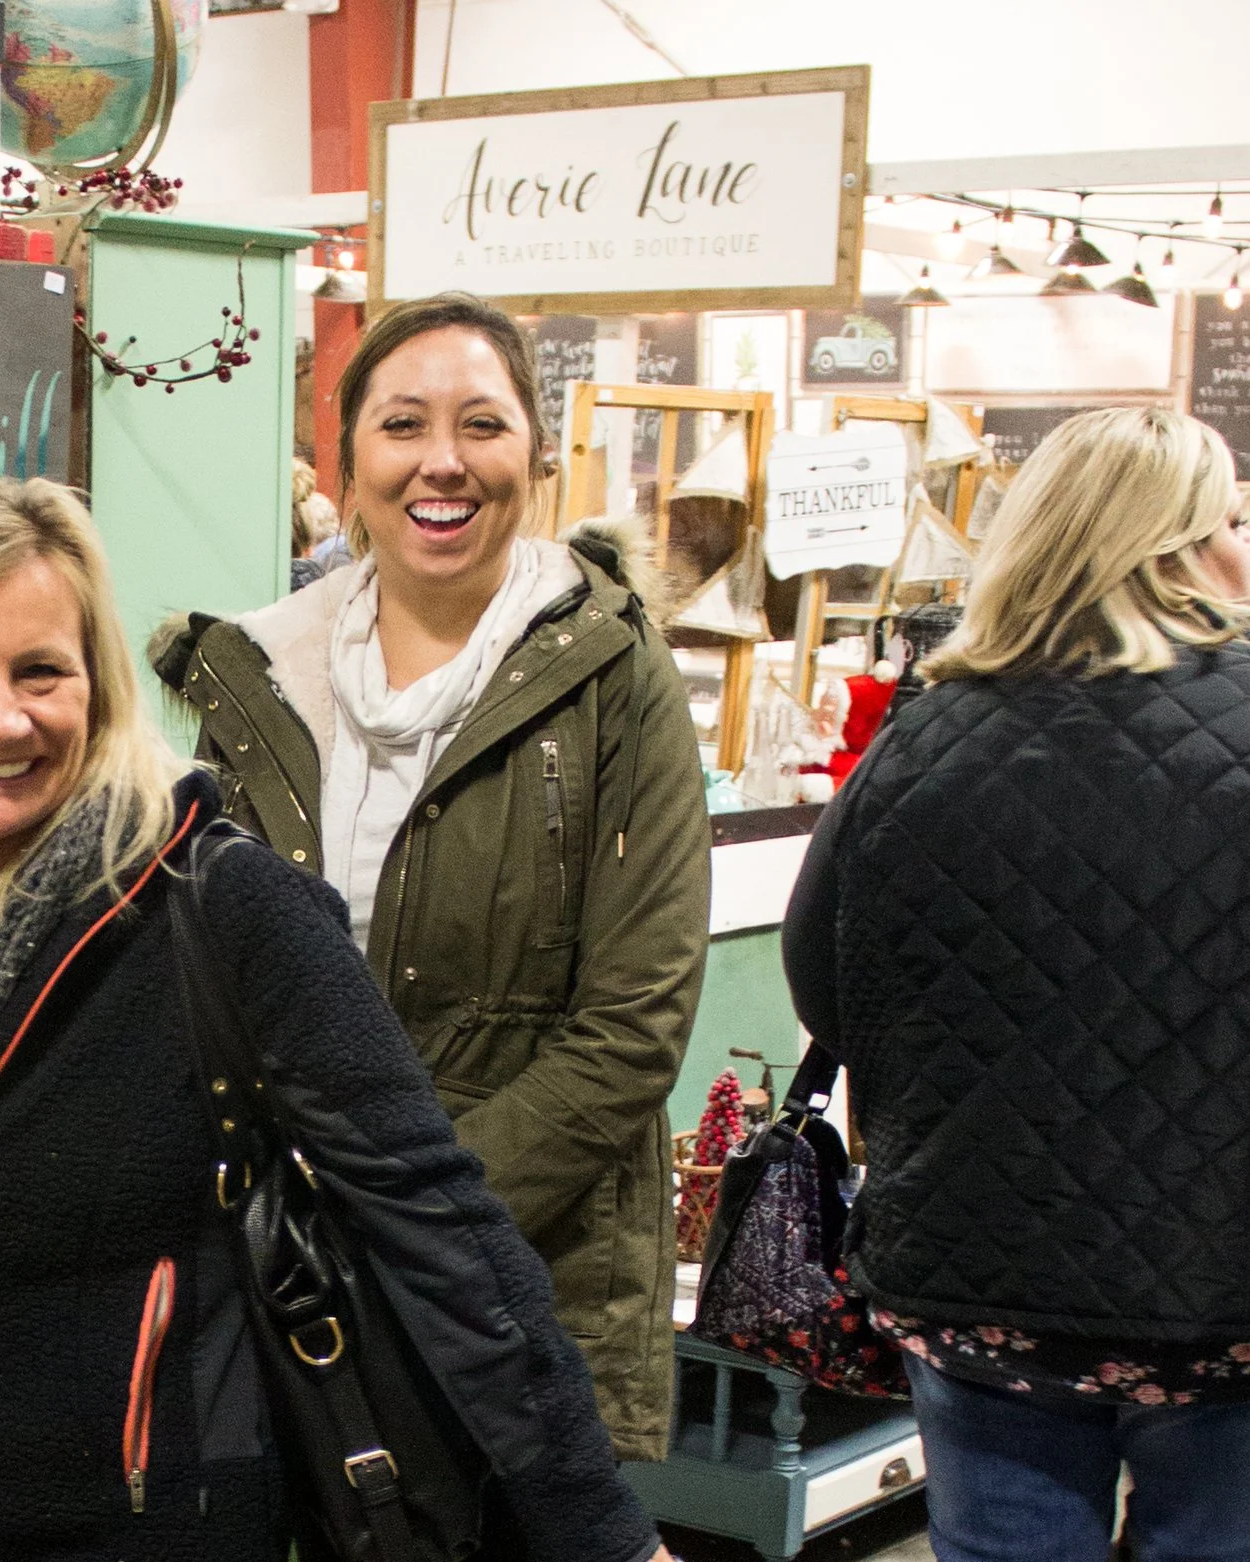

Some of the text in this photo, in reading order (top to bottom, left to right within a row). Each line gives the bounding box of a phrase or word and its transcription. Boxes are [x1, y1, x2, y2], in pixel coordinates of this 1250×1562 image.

[442, 120, 758, 241] Averie Lane
[483, 239, 616, 265] TRAVELING
[633, 233, 760, 258] BOUTIQUE
[779, 482, 897, 517] THANKFUL
